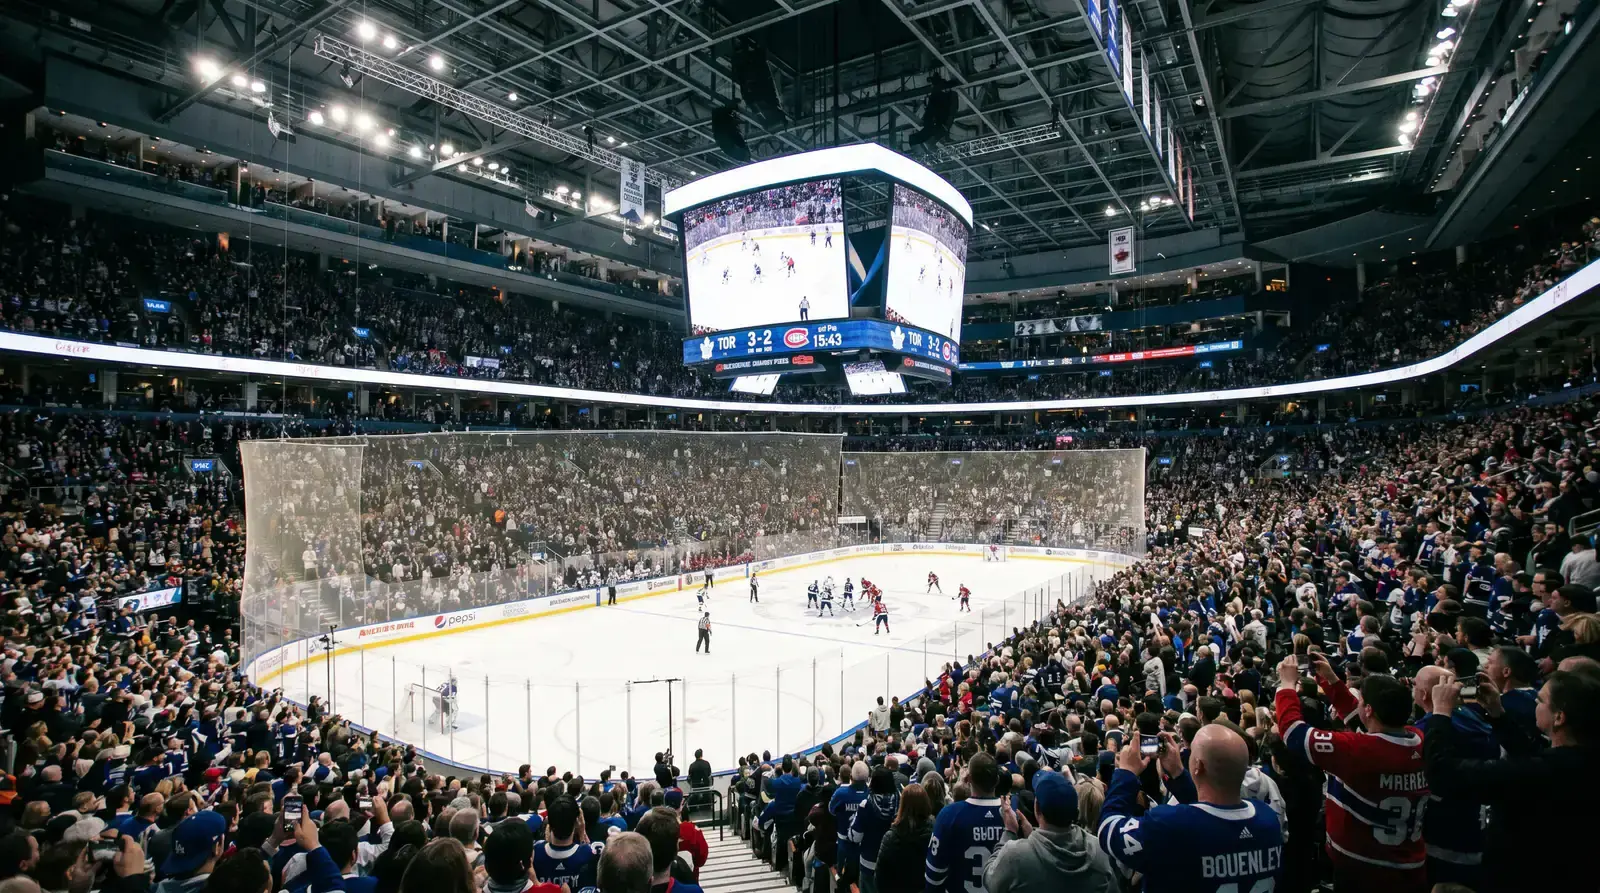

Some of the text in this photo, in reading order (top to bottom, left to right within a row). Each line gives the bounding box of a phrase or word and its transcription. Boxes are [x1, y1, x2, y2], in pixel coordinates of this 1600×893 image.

[717, 335, 736, 350] TOR
[813, 333, 842, 347] 15:43
[908, 331, 922, 347] TOR
[448, 611, 476, 627] pepsi
[1313, 731, 1334, 752] 38
[1119, 817, 1143, 855] 44
[1201, 845, 1282, 878] BOUENLEY
